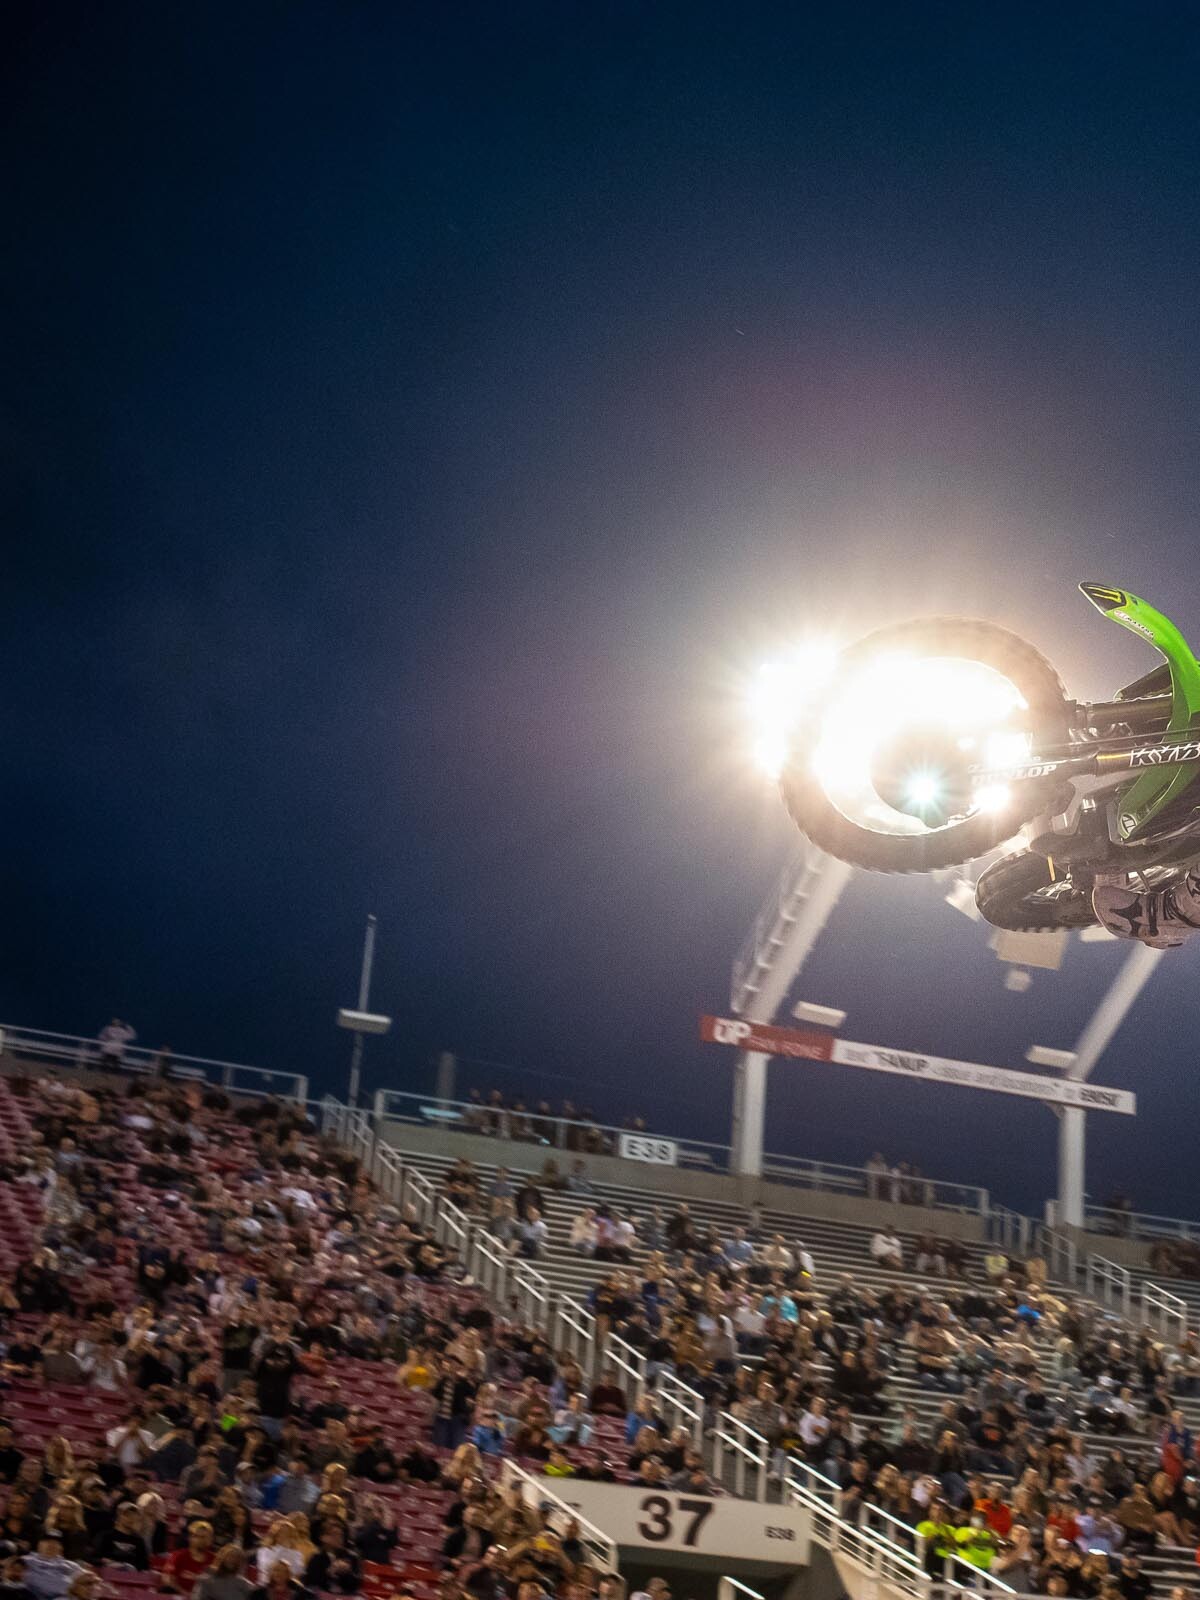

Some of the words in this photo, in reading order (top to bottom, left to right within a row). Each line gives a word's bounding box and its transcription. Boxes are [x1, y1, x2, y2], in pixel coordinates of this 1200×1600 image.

[1129, 741, 1200, 768] KYB
[627, 1139, 671, 1161] E38
[637, 1495, 715, 1548] 37
